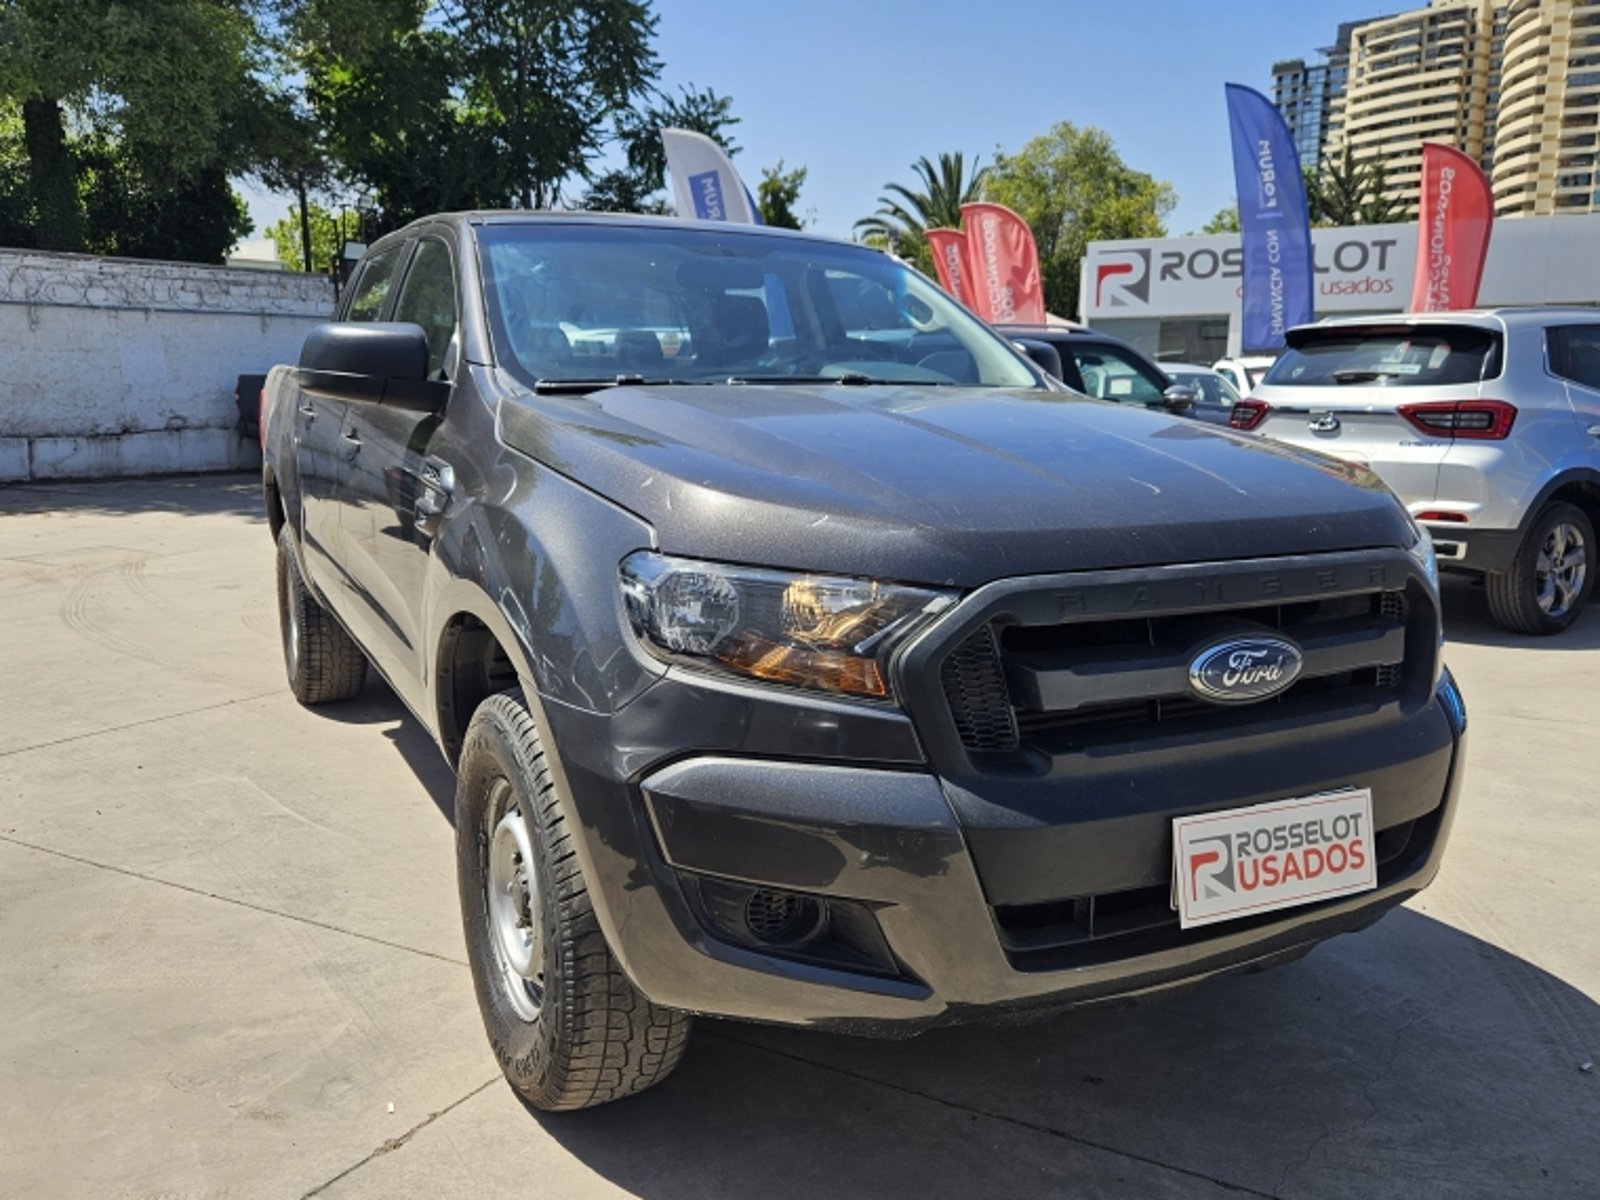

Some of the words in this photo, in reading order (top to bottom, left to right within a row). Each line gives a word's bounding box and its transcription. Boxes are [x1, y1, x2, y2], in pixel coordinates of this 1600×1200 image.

[1159, 239, 1397, 282] ROSLOT
[1320, 275, 1394, 296] usados
[1222, 649, 1283, 688] Ford
[1235, 812, 1363, 858] ROSSELOT
[1237, 839, 1366, 892] USADOS
